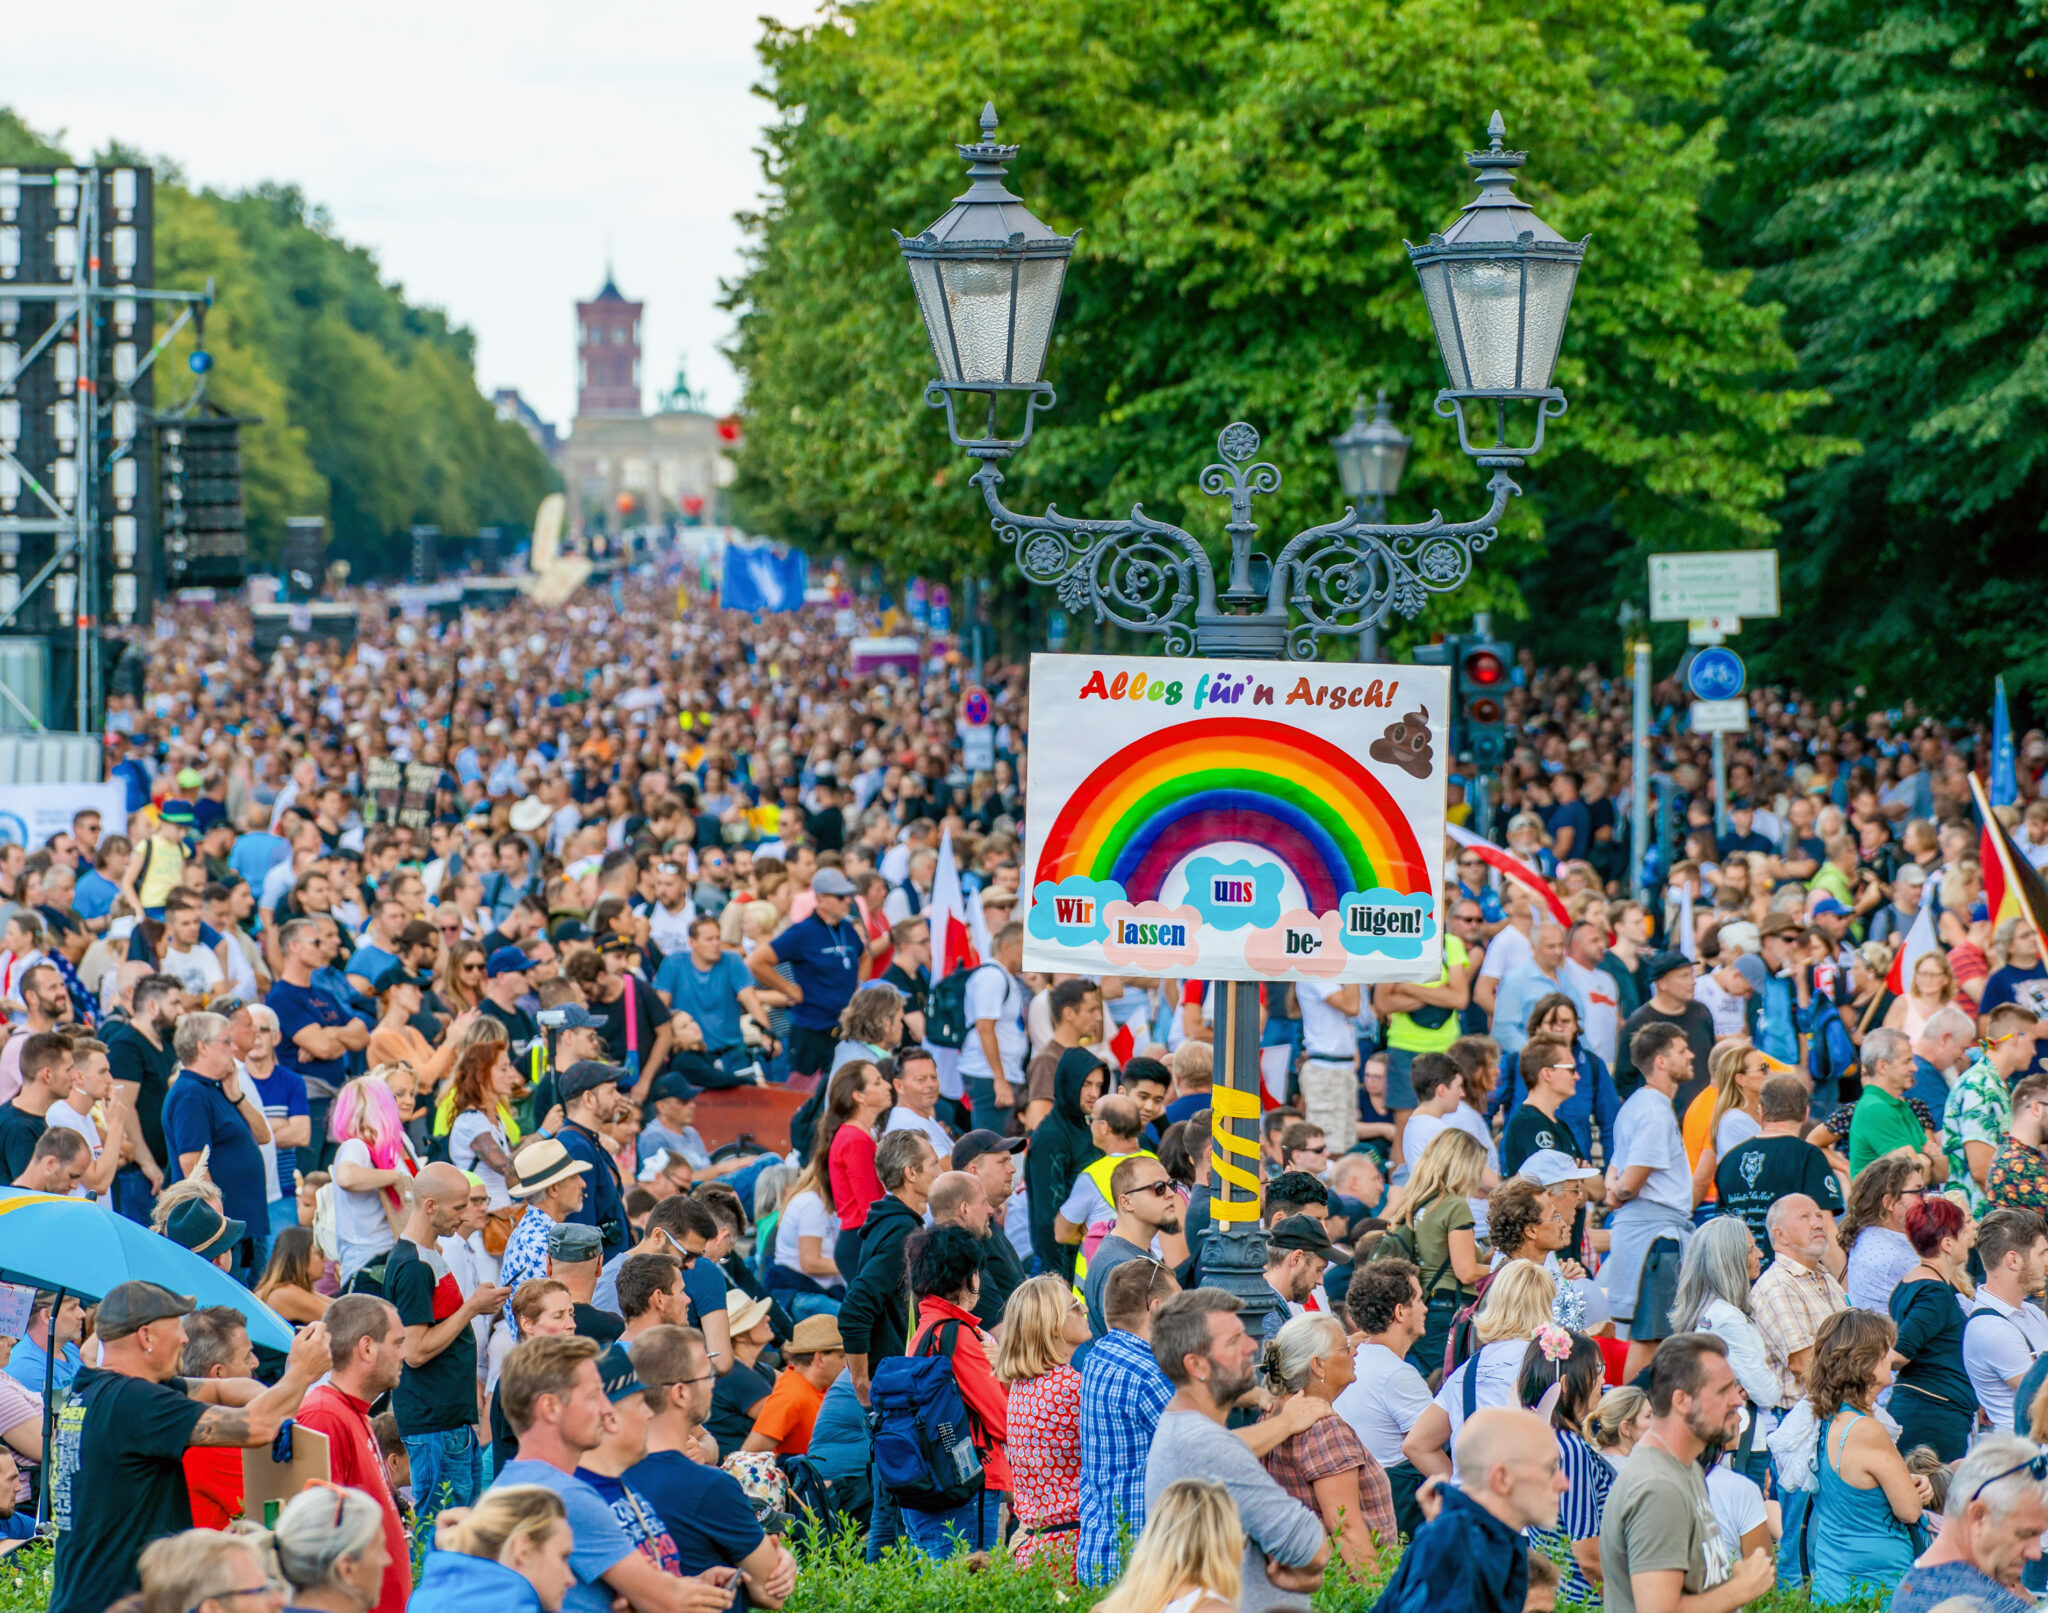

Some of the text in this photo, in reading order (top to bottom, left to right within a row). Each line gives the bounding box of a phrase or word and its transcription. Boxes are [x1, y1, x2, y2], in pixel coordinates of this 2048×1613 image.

[1078, 670, 1184, 706] Alles
[1284, 676, 1400, 710] Arsch!
[1054, 879, 1422, 955] Wir lassen uns be- lügen!
